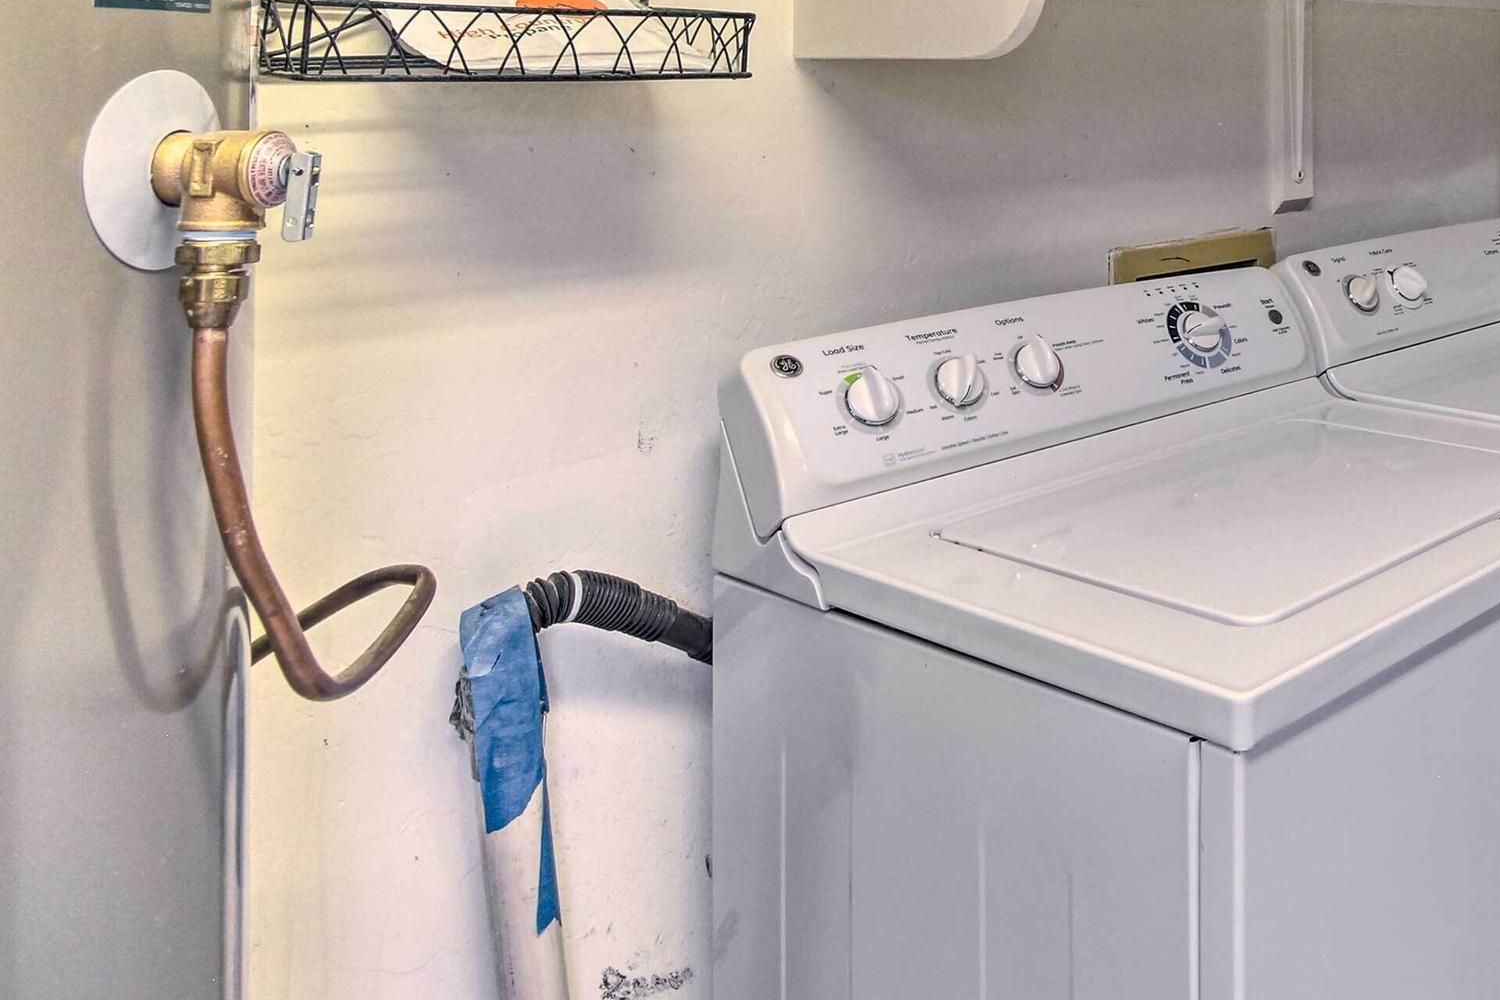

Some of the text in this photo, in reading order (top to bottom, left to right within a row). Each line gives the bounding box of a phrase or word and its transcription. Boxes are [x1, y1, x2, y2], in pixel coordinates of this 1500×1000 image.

[994, 316, 1024, 328] Options
[905, 328, 958, 342] Temperature
[1233, 336, 1248, 344] Colors
[821, 343, 865, 357] Load Size
[1220, 364, 1241, 375] Delicates
[1164, 371, 1190, 382] Permanent
[1180, 377, 1194, 385] Press
[906, 407, 924, 415] Medium
[834, 429, 849, 437] Large
[876, 434, 890, 442] Large
